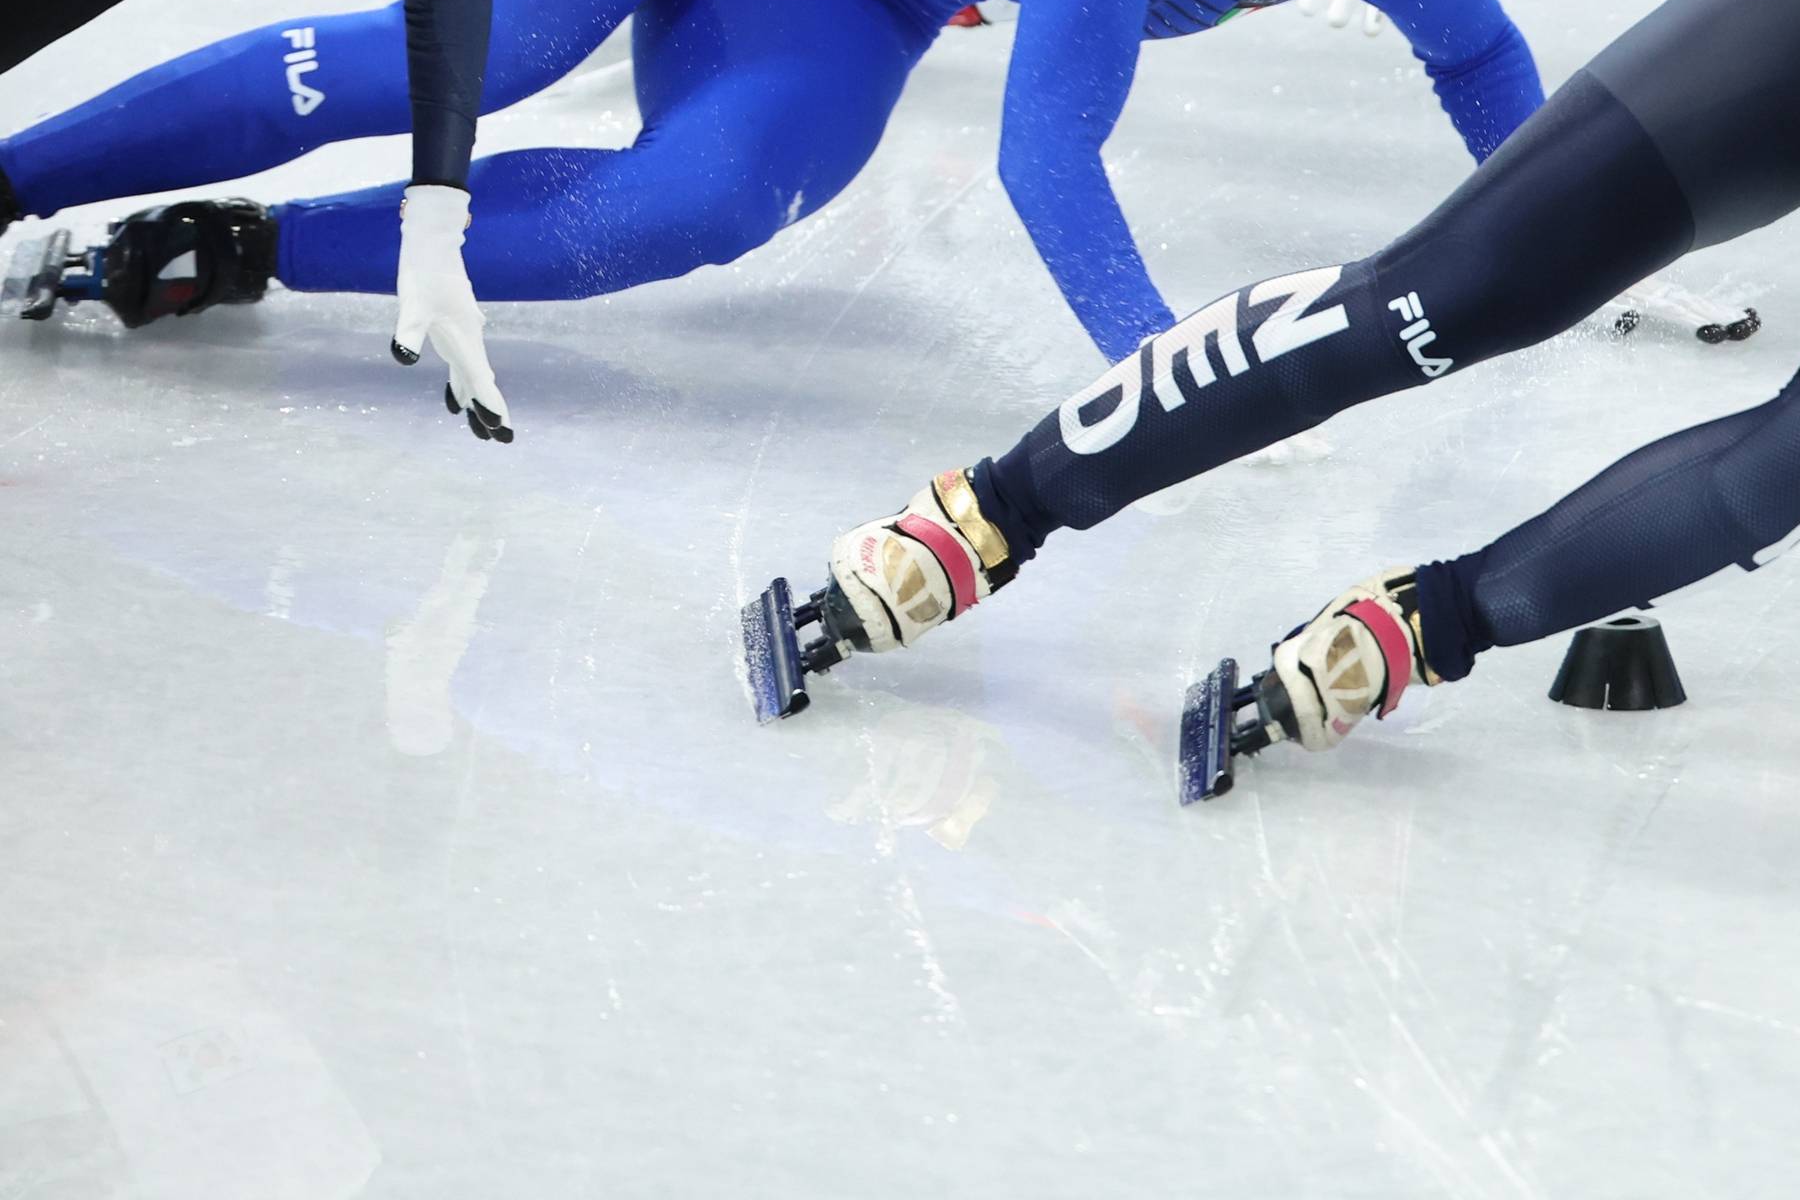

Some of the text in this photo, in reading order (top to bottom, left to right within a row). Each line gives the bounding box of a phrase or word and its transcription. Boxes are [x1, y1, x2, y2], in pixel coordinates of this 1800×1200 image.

[281, 26, 326, 116] FILA
[1058, 263, 1350, 456] NED
[1388, 291, 1454, 378] FILA
